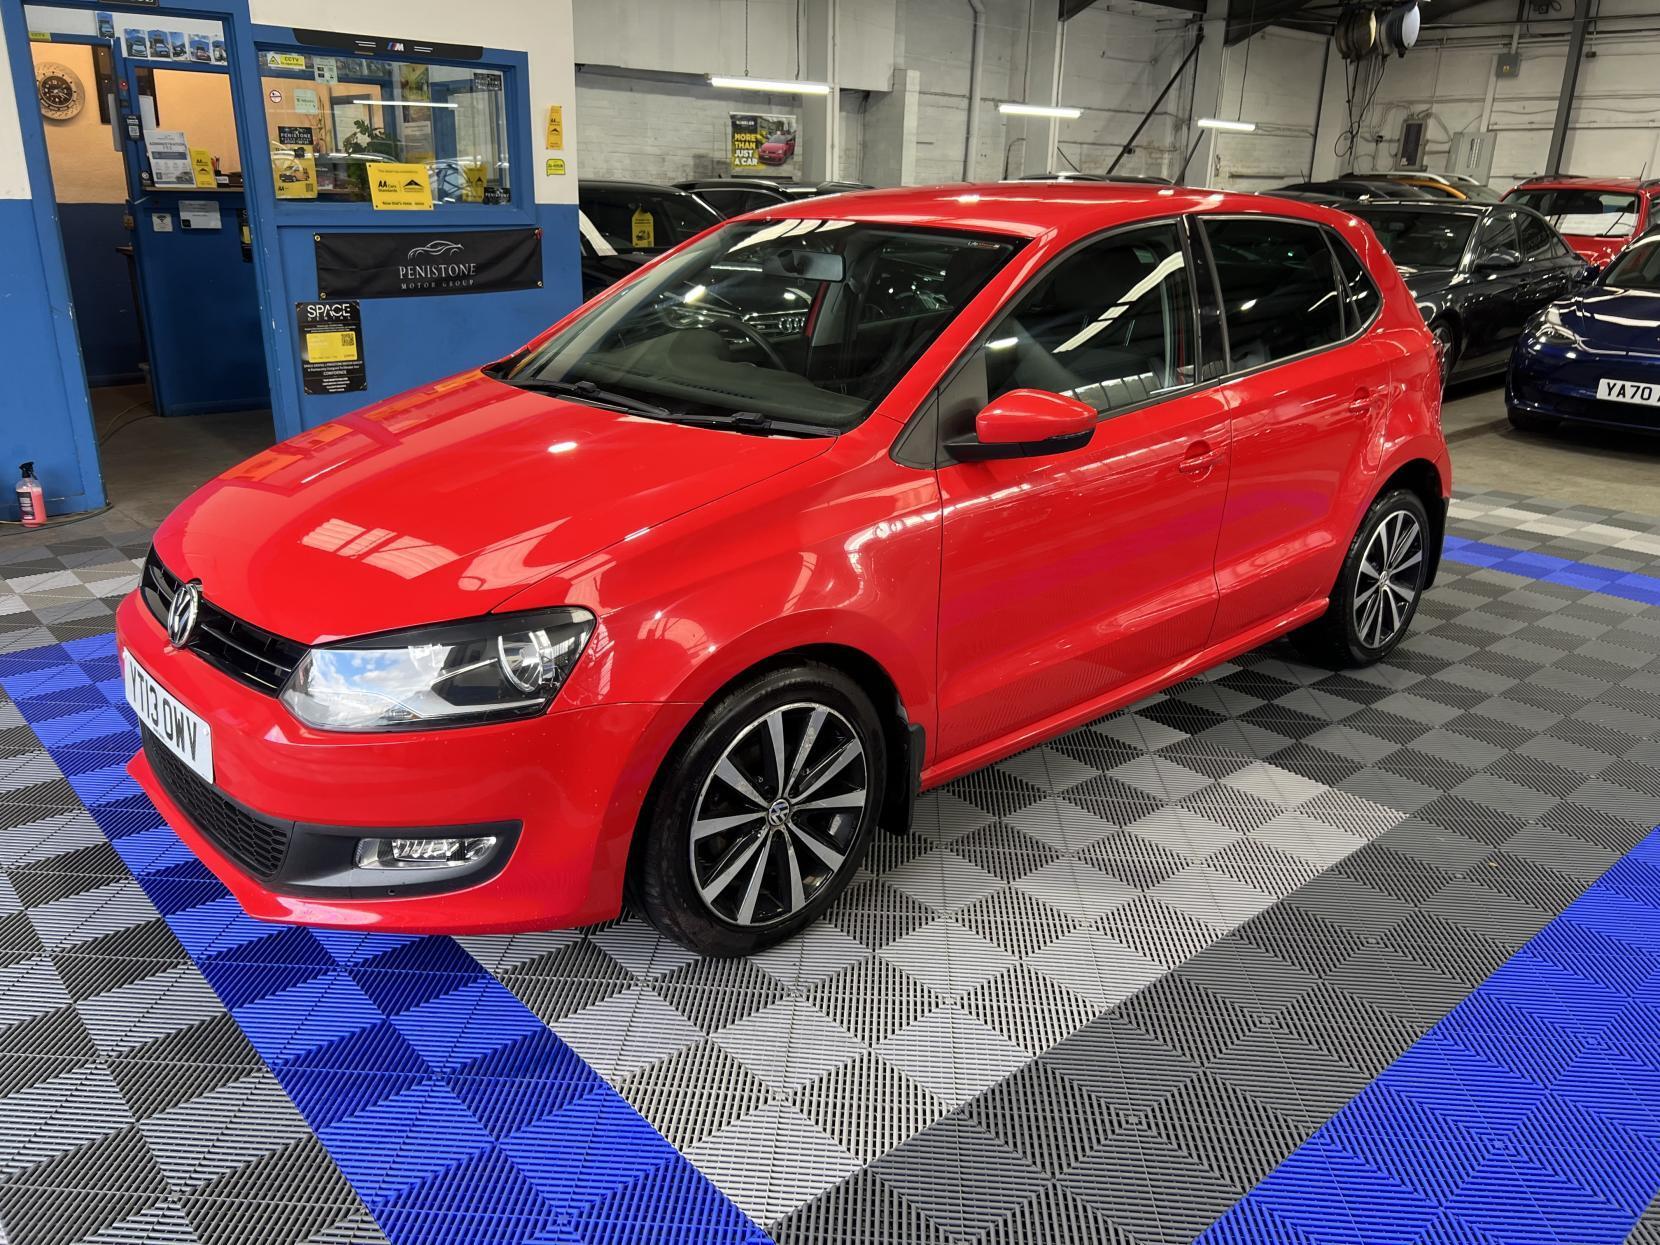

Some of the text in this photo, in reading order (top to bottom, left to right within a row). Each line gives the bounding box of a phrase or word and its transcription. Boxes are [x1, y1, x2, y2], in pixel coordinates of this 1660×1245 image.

[734, 133, 756, 141] MORE
[734, 141, 756, 149] THAN
[734, 149, 754, 157] JUST
[378, 179, 388, 188] AA
[400, 263, 476, 279] PENISTONE
[443, 279, 474, 287] GROUP
[307, 303, 351, 317] SPACE
[1607, 382, 1653, 401] YA70
[130, 661, 197, 761] YT13 OWV
